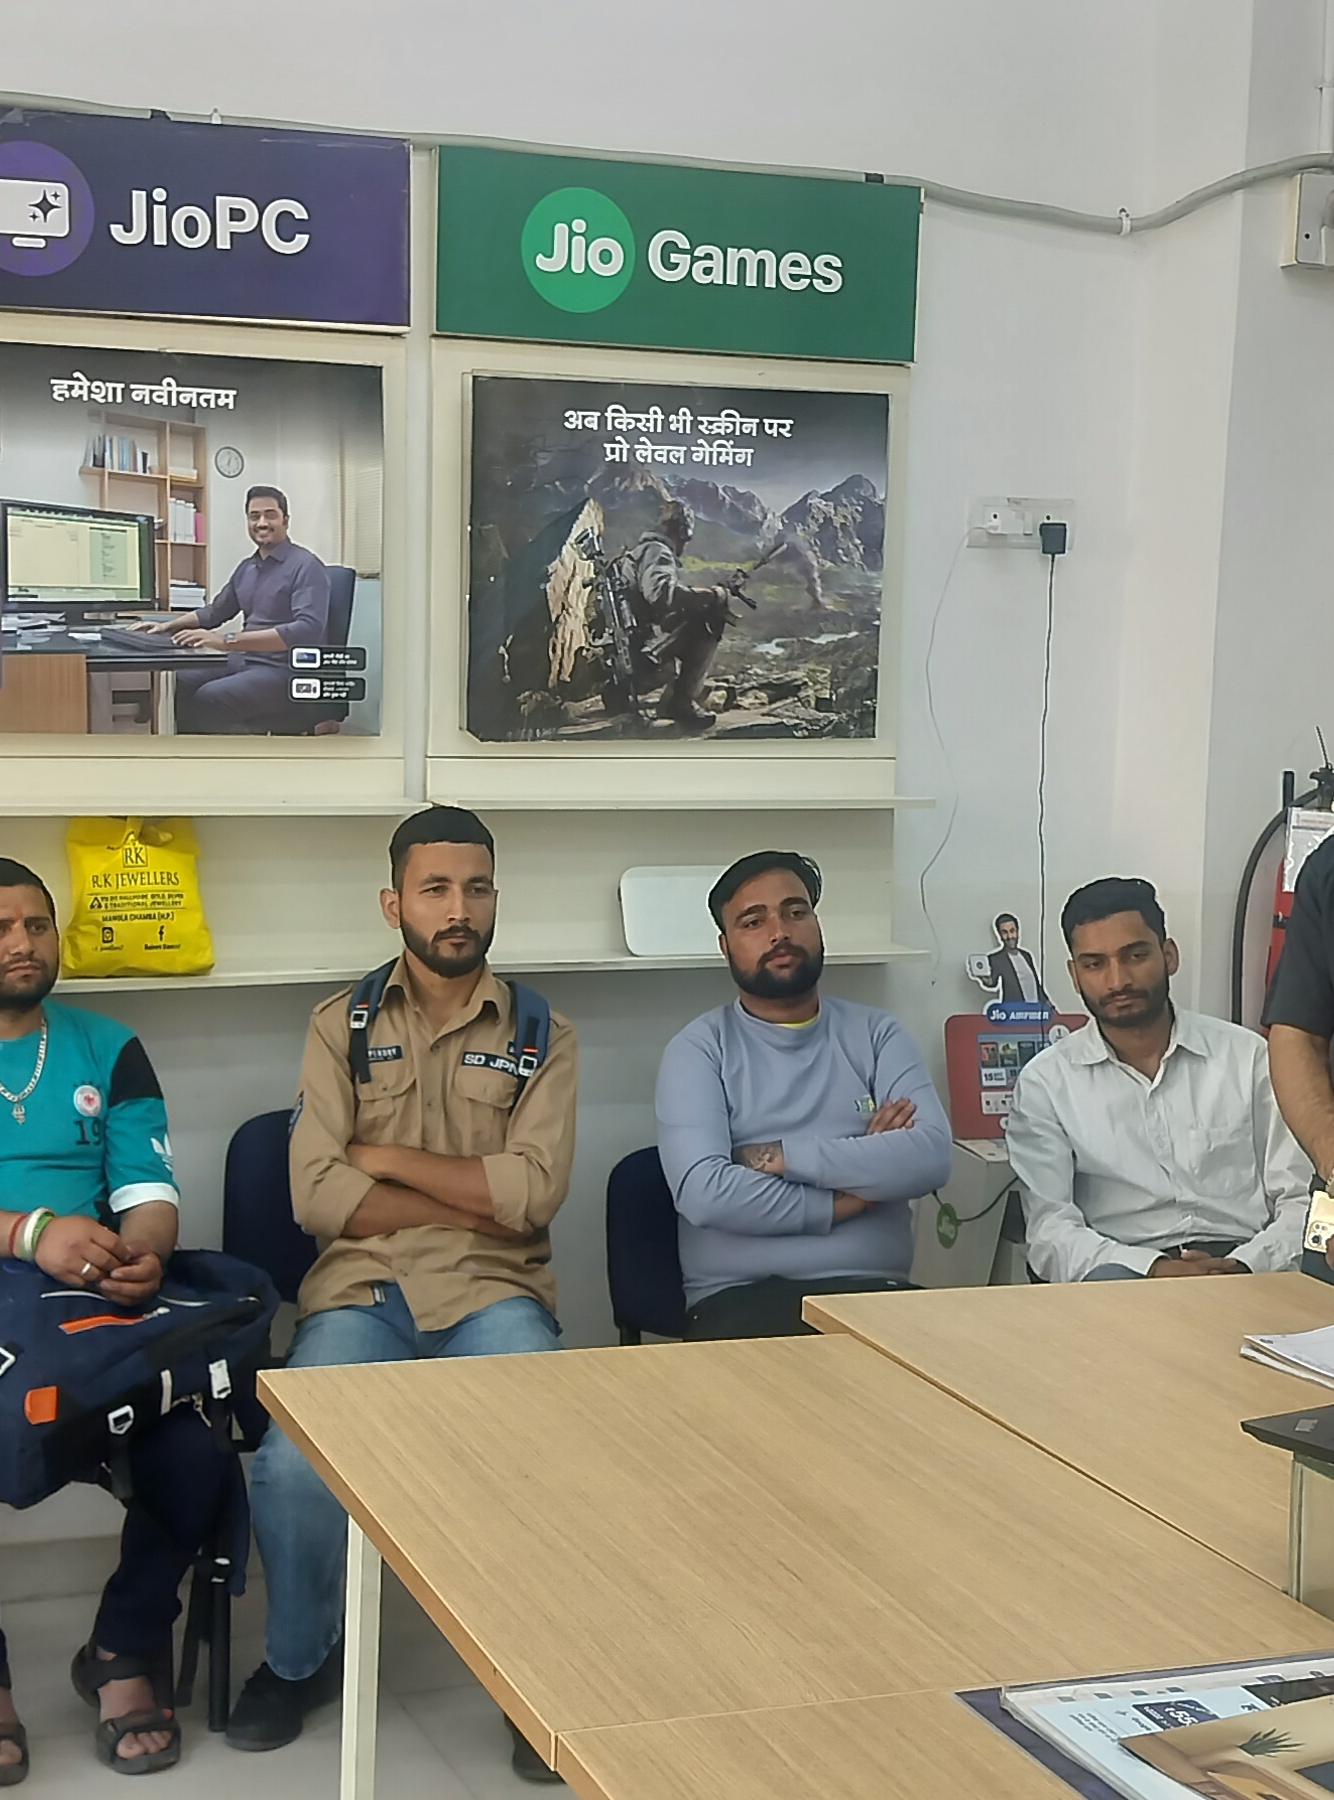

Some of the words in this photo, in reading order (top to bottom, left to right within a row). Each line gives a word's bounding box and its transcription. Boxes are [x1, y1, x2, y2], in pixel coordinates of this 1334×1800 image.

[109, 187, 312, 256] JioPC
[534, 218, 624, 276] Jio
[647, 230, 844, 294] Games
[50, 371, 125, 404] हमेशा
[130, 376, 237, 410] नवीनतम
[564, 410, 601, 432] अब
[605, 404, 665, 433] किसी
[669, 407, 693, 434] भी
[697, 409, 760, 437] स्क्रीन
[763, 418, 794, 438] पर
[603, 436, 631, 463] प्रो
[634, 436, 688, 465] लेवल
[691, 439, 755, 467] गेमिंग
[125, 847, 145, 864] RK
[115, 871, 180, 890] JEWELLERS
[989, 1008, 1007, 1021] Jio
[464, 1053, 486, 1065] SD
[73, 1117, 105, 1146] 19
